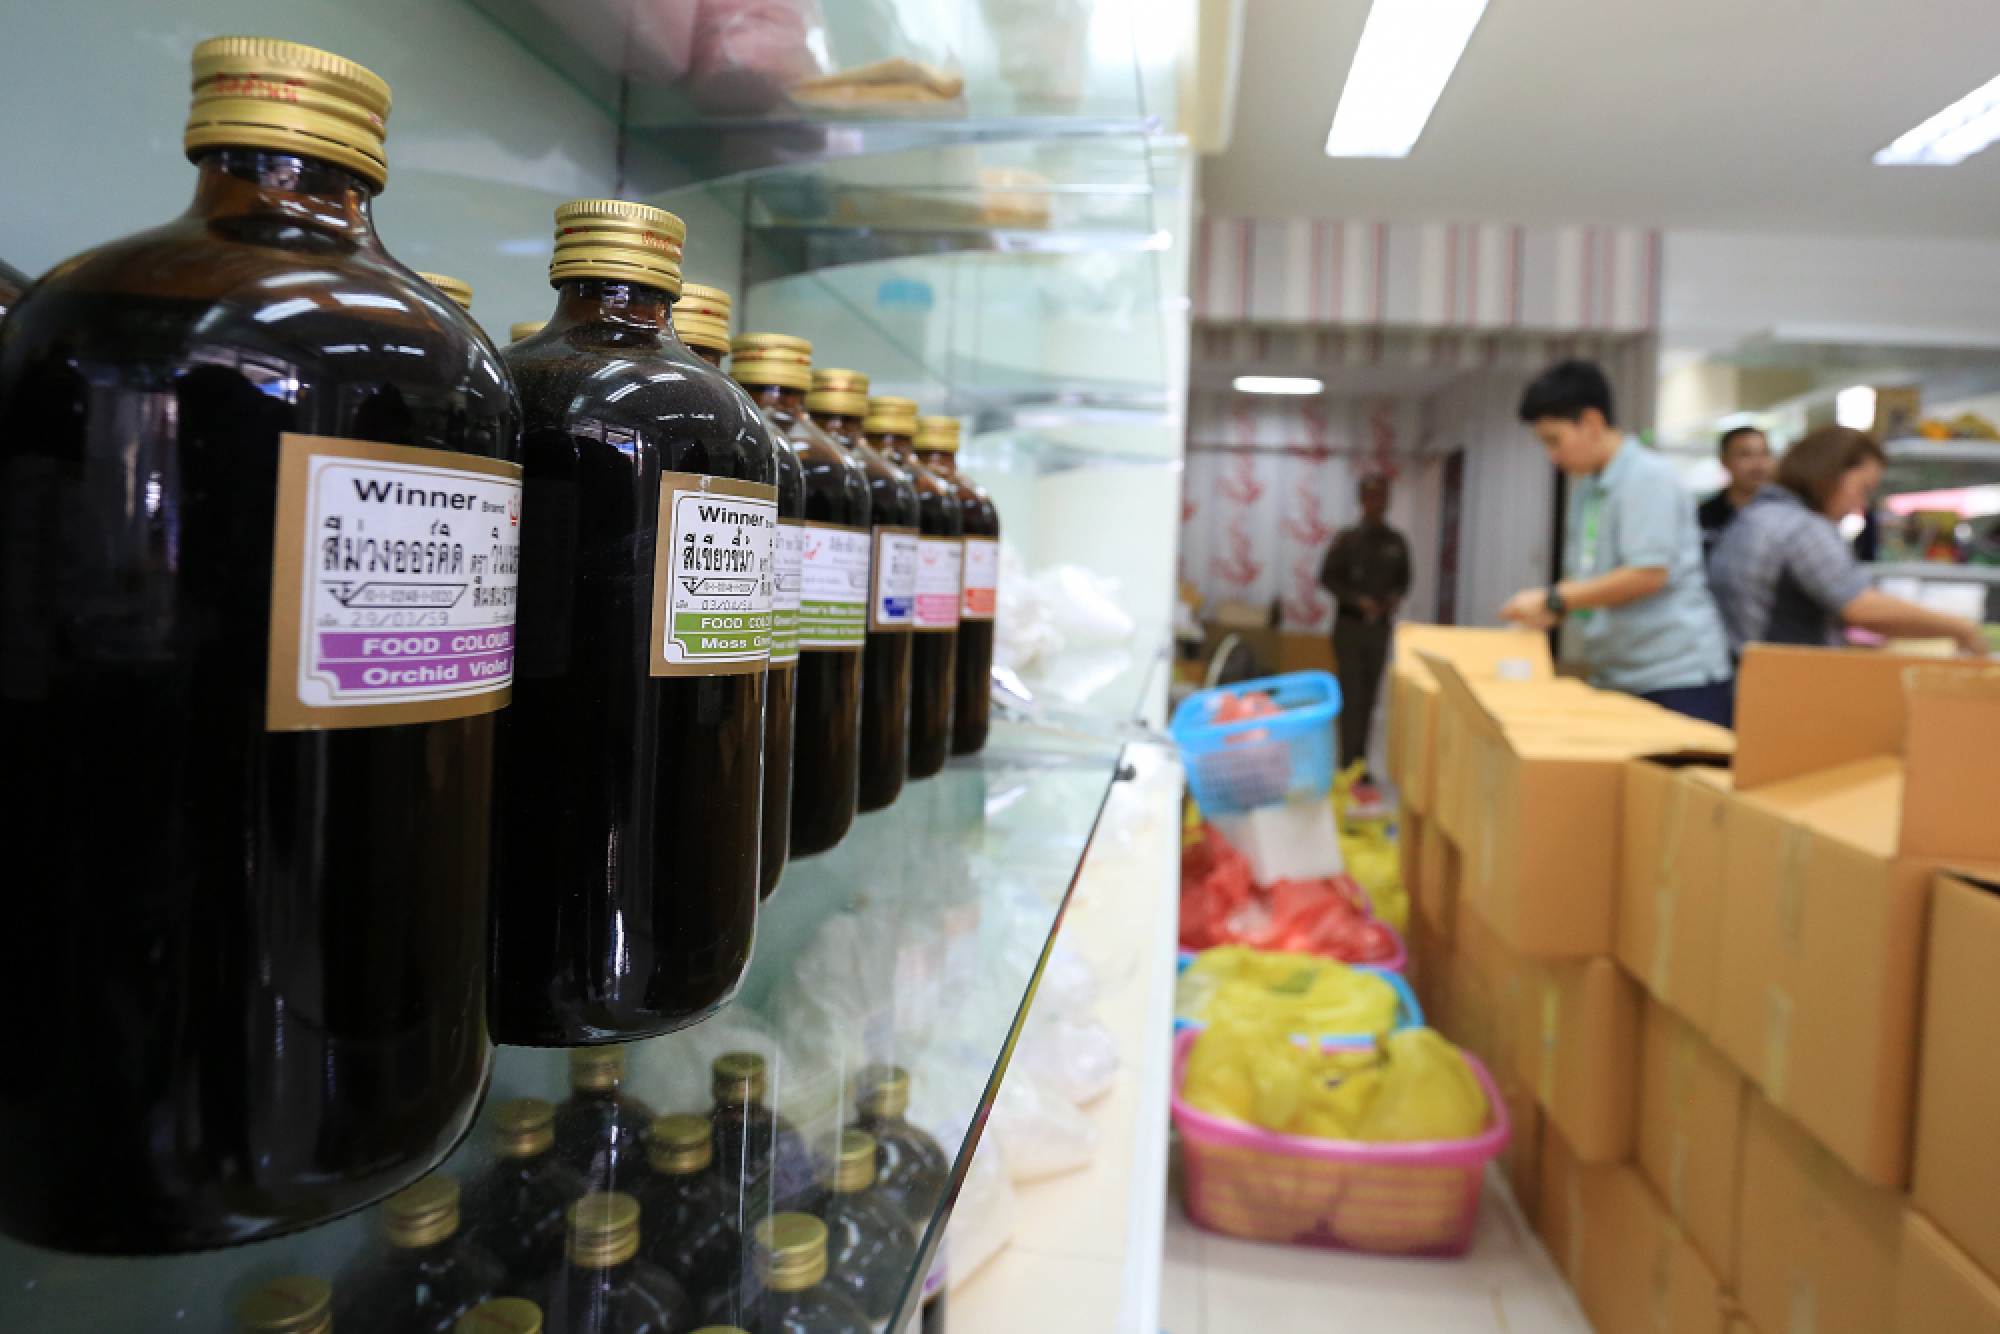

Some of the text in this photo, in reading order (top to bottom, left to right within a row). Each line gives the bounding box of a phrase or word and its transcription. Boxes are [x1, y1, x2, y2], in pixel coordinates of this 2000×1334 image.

[353, 479, 477, 510] Winner
[698, 505, 764, 527] Winner
[701, 617, 744, 629] FOOD
[363, 637, 440, 655] FOOD
[701, 637, 747, 649] Moss
[362, 664, 458, 685] Orchid
